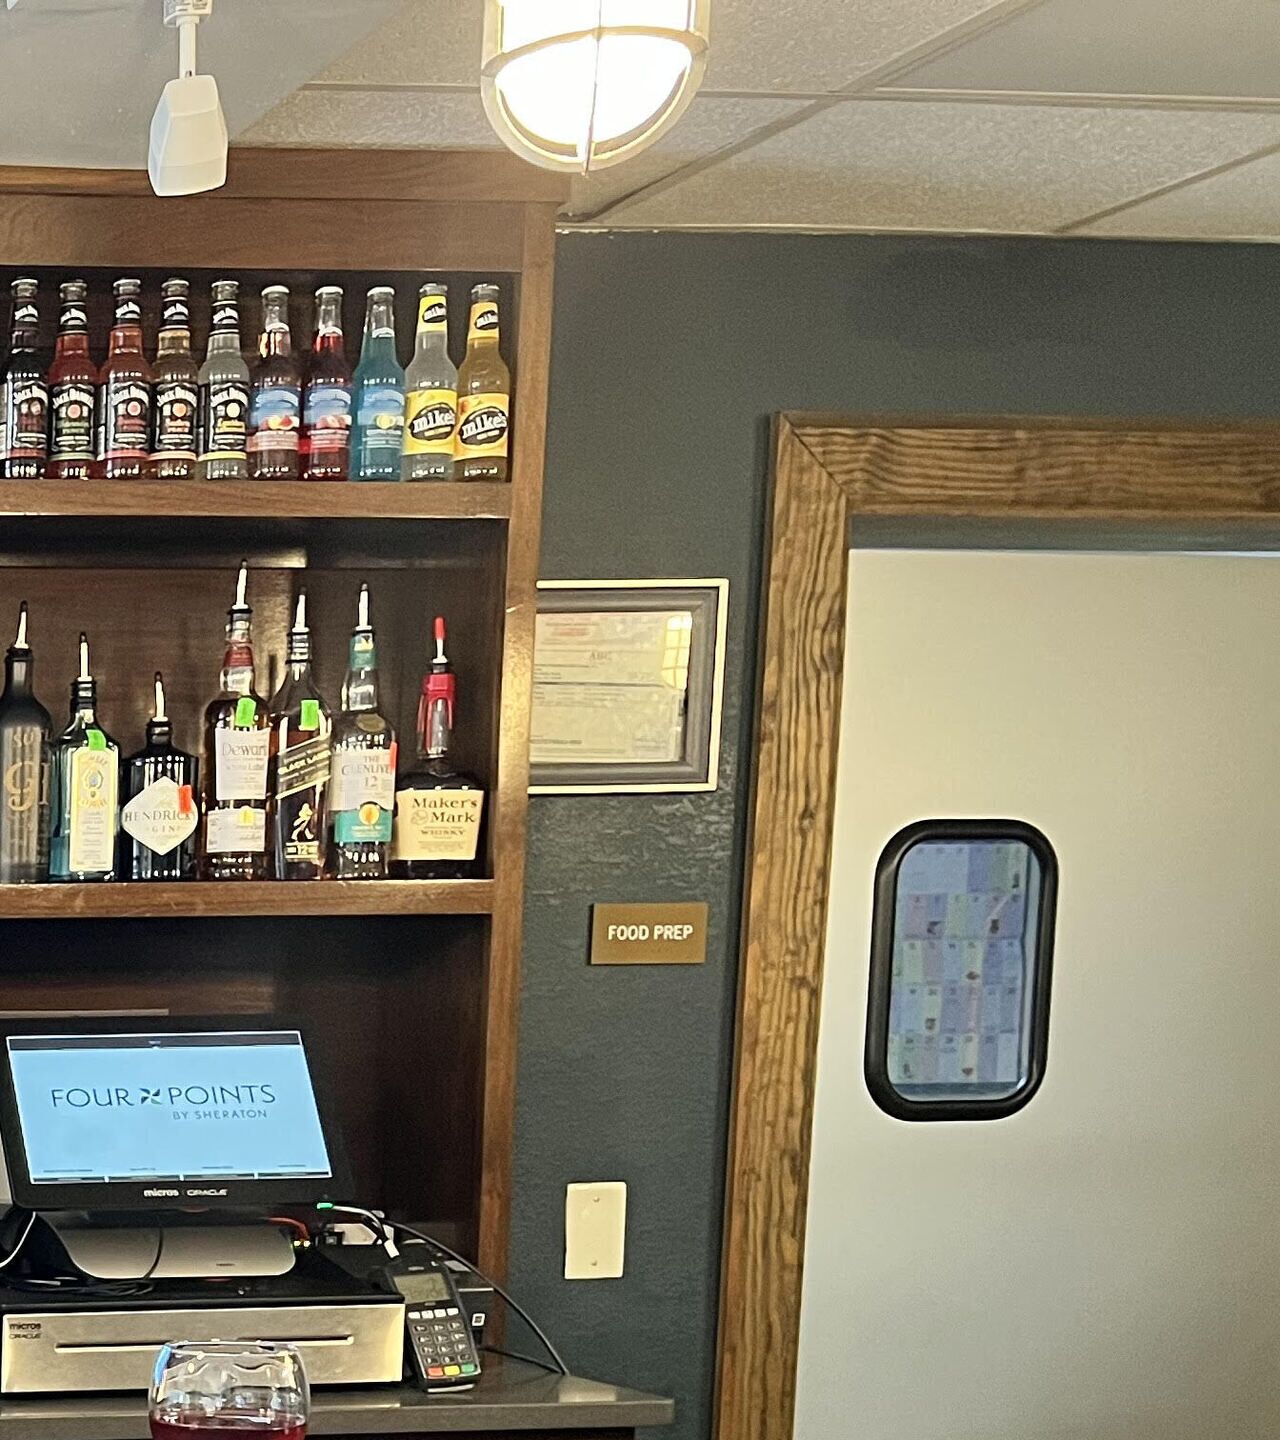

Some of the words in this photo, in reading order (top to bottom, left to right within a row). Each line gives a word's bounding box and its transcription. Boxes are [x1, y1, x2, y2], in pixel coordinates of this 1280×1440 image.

[460, 413, 508, 439] mike's
[363, 776, 378, 788] 12
[412, 797, 478, 810] Maker's
[429, 811, 476, 824] Mark
[151, 825, 176, 833] GIN
[420, 829, 465, 837] WHISKY
[608, 924, 650, 941] FOOD
[653, 924, 694, 941] PREP
[50, 1087, 135, 1109] FOUR
[168, 1084, 277, 1106] POINTS
[172, 1110, 189, 1121] BY
[194, 1108, 268, 1121] SHERATON
[143, 1188, 180, 1198] micros
[186, 1188, 229, 1197] ORACLE
[8, 1322, 42, 1331] micros
[8, 1332, 42, 1340] ORACLE
